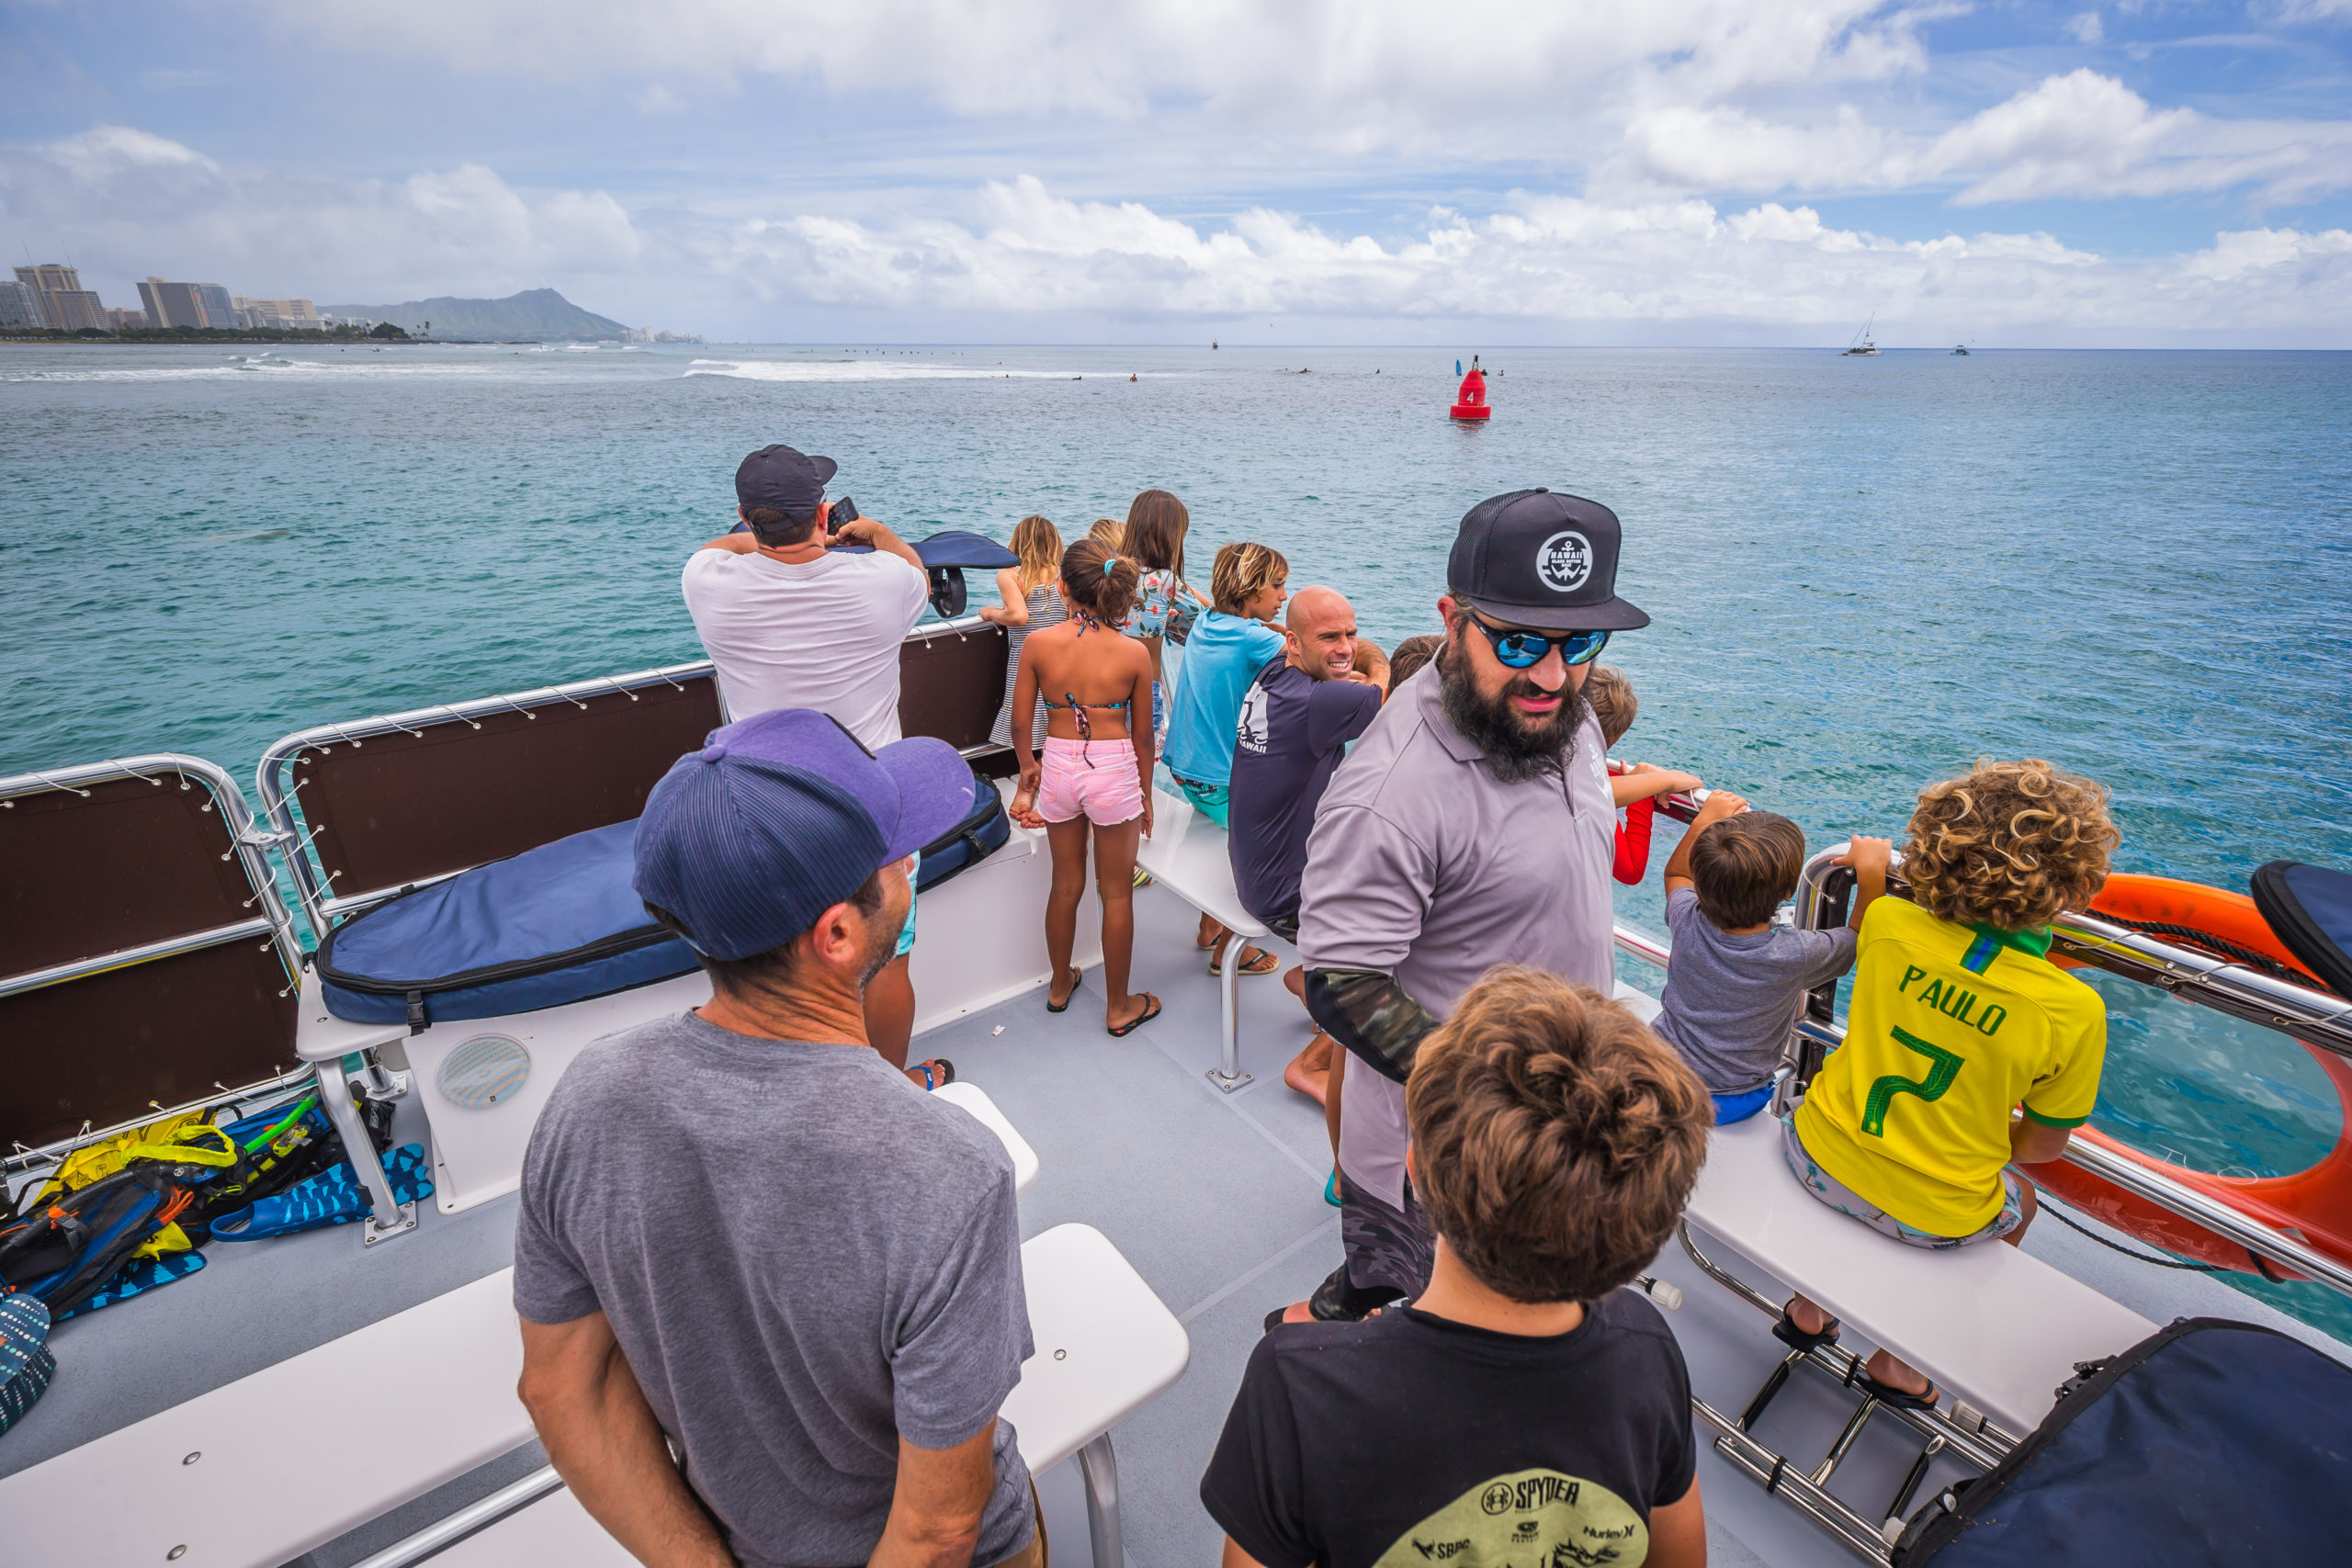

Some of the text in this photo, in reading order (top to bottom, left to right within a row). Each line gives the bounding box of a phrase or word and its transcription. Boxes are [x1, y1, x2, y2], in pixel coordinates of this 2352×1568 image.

[1466, 391, 1475, 404] 4
[1898, 964, 2007, 1037] PAULO
[1861, 1024, 1966, 1139] 7
[1515, 1476, 1580, 1509] SPYDER
[1582, 1525, 1624, 1540] Hurley
